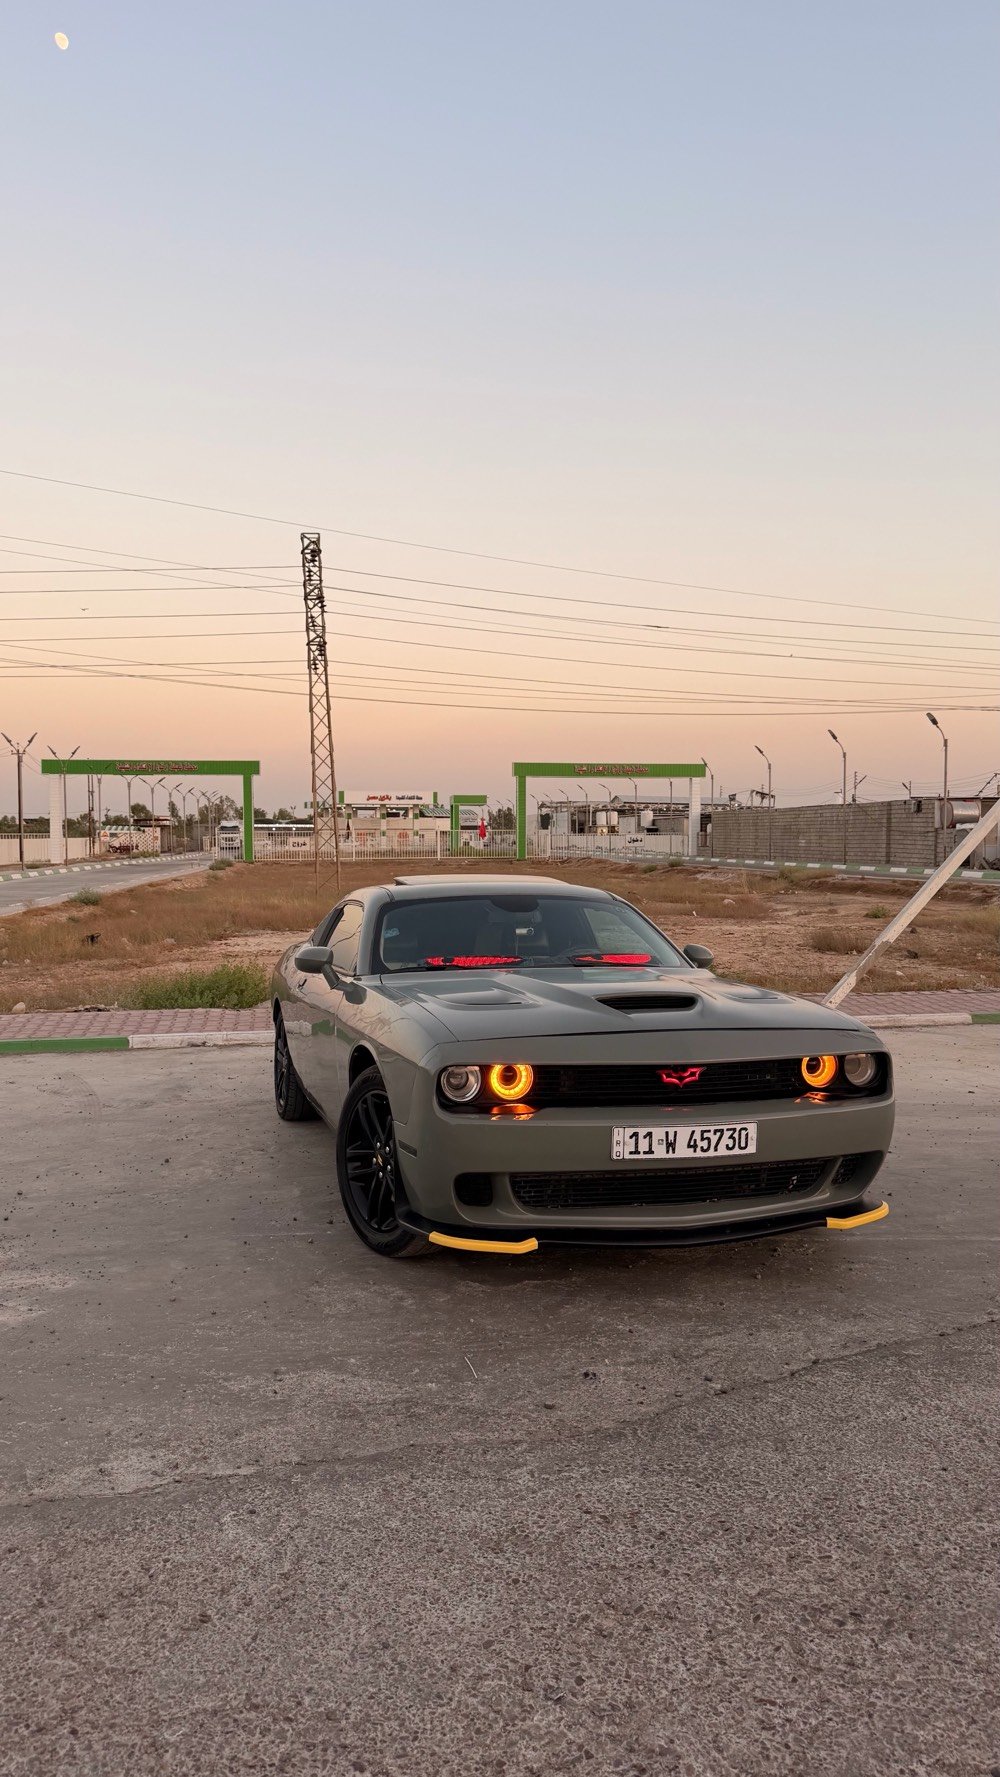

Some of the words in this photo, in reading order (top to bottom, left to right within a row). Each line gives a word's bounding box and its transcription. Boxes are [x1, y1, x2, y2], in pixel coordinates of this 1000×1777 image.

[291, 840, 307, 848] خروج
[627, 836, 643, 844] دخول
[628, 1131, 655, 1155] 11
[665, 1130, 678, 1154] W
[686, 1126, 749, 1154] 45730
